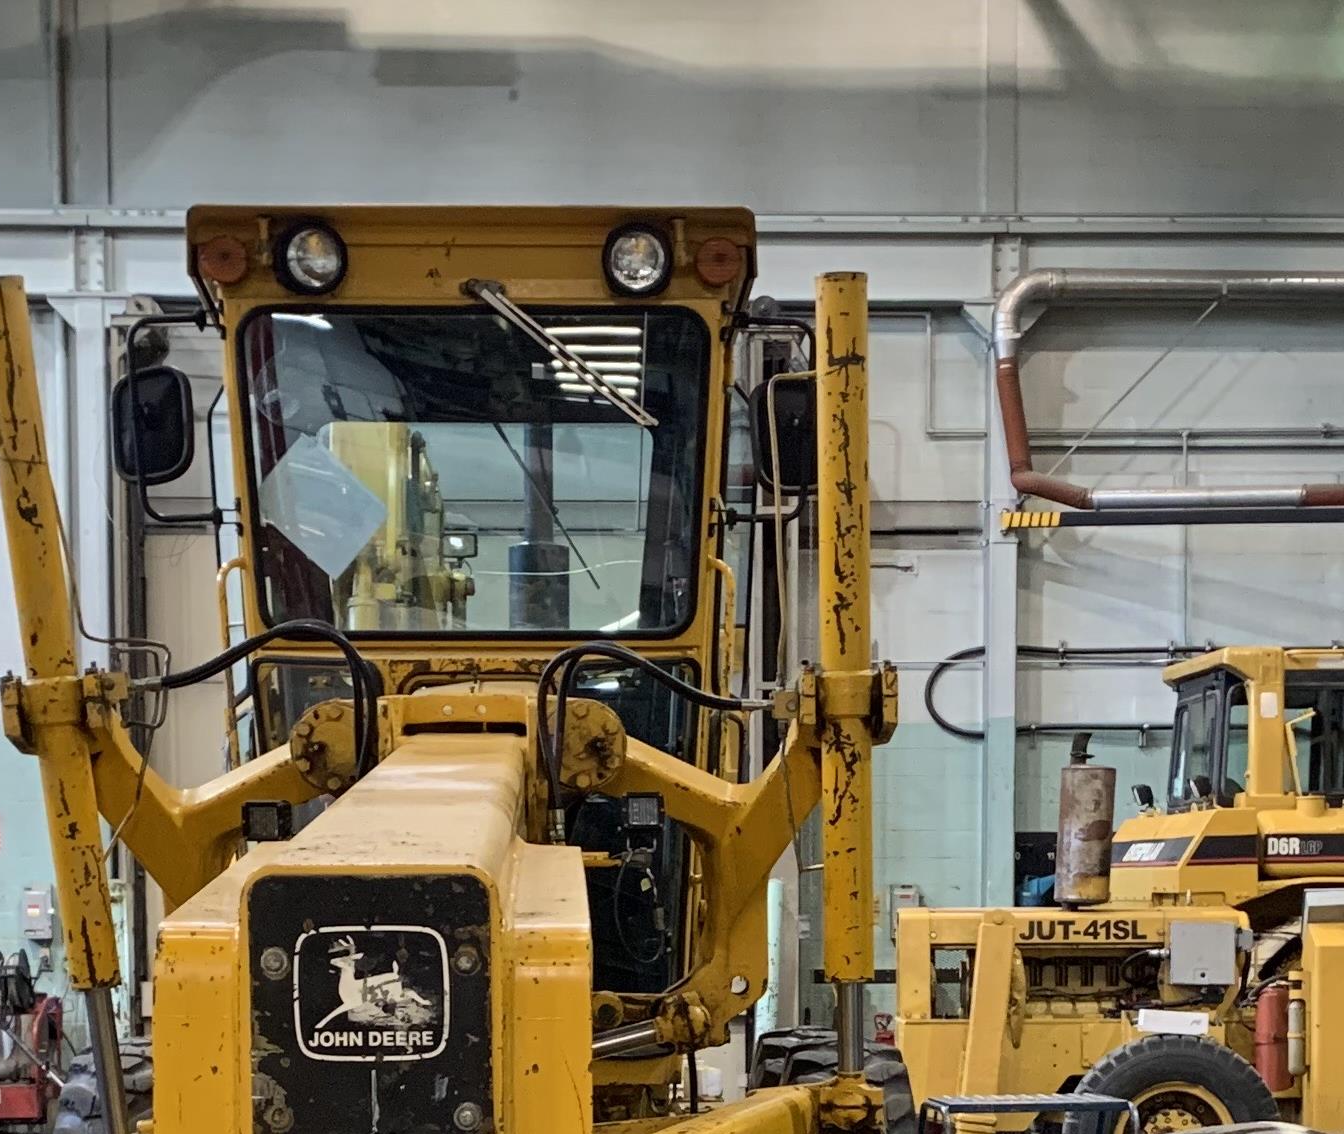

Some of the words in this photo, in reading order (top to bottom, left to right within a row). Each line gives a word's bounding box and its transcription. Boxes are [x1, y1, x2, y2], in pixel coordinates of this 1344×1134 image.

[1267, 837, 1300, 855] D6R
[1019, 919, 1147, 940] JUT-41SL
[308, 1031, 363, 1047] JOHN
[368, 1031, 434, 1047] DEERE
